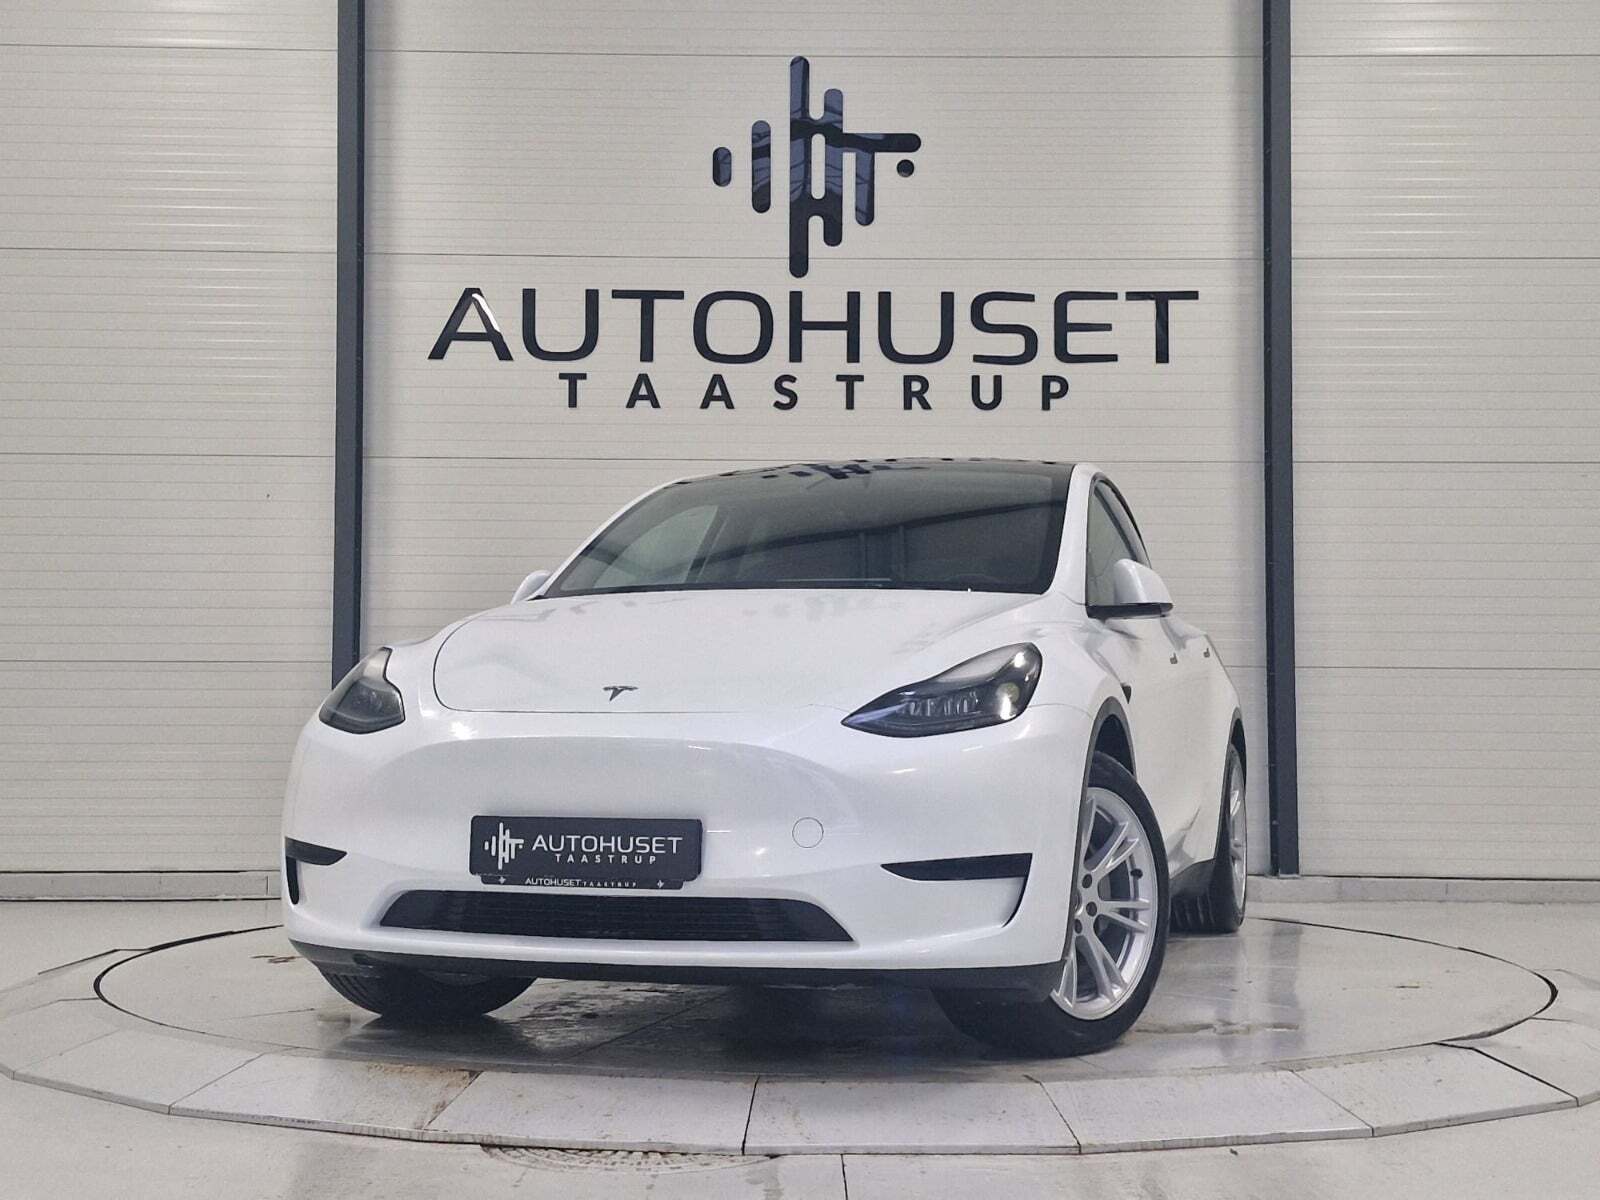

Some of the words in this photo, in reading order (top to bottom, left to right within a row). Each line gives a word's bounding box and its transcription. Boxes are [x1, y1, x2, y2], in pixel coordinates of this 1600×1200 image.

[428, 287, 1199, 365] AUTOHUSET
[558, 372, 1070, 412] TAASTRUP
[532, 834, 683, 854] AUTOHUSET
[555, 854, 656, 864] TAASTRUP
[525, 877, 581, 887] AUTOHUSET
